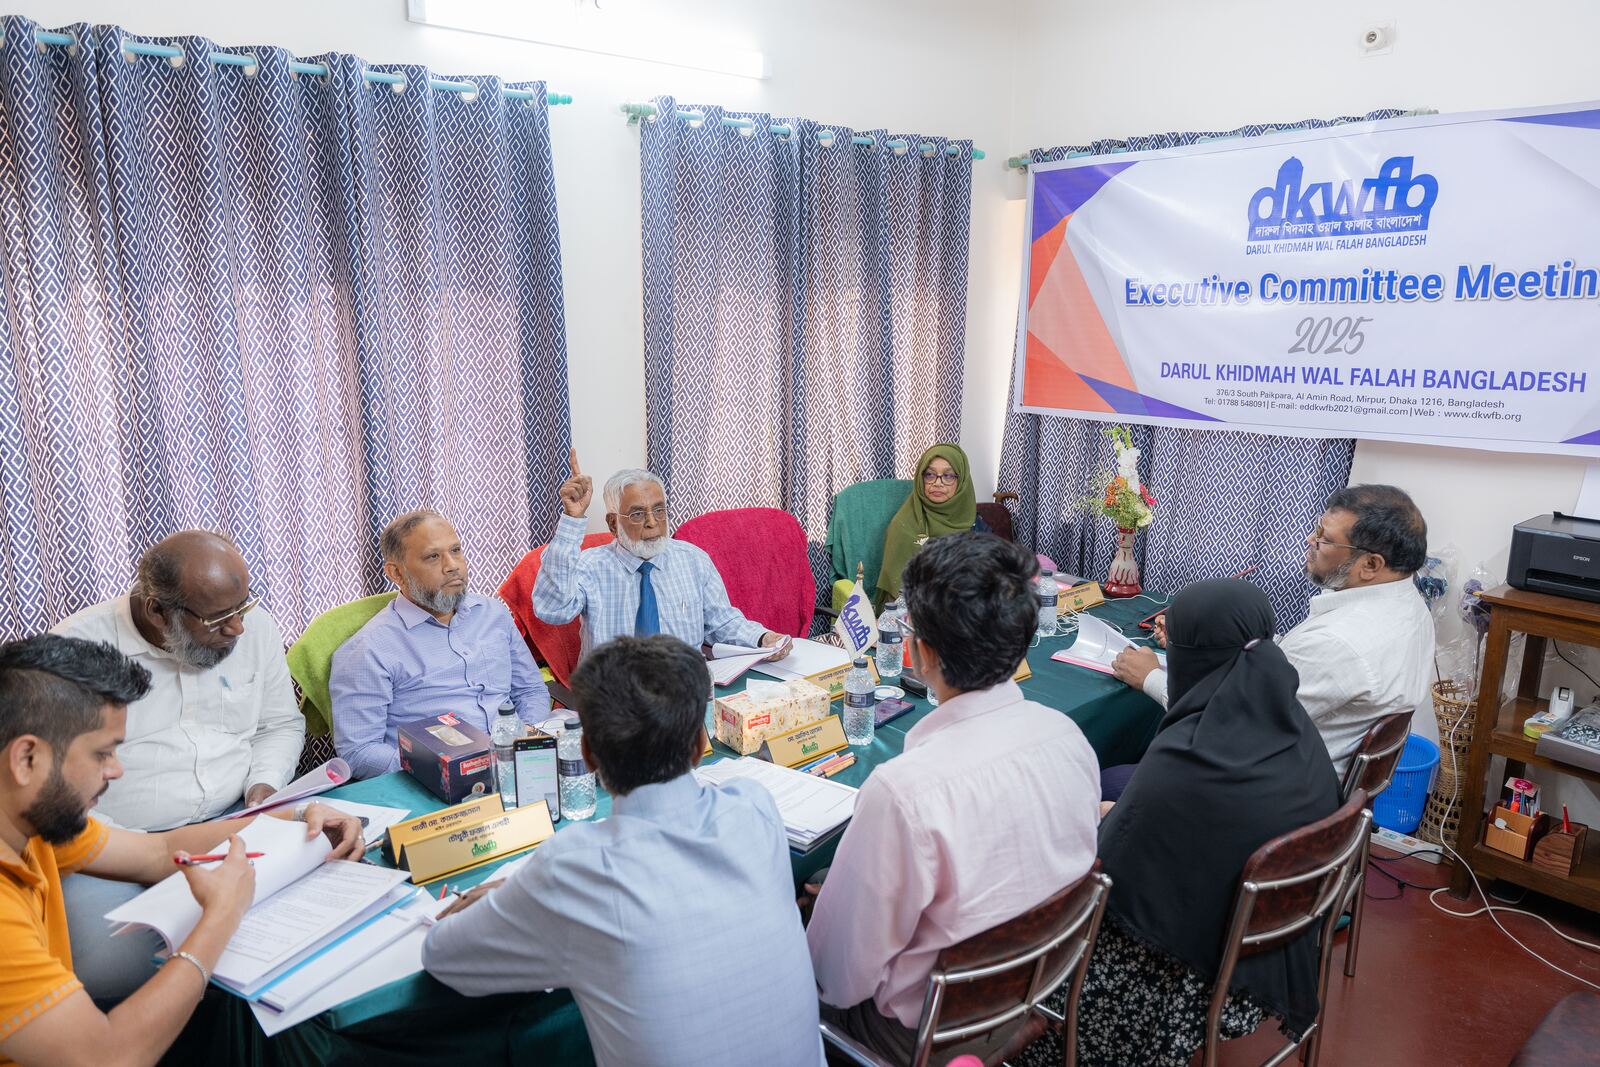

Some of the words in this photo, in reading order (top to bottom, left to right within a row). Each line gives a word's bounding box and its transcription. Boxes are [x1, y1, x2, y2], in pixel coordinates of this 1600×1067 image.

[1255, 225, 1280, 237] দারুল
[1344, 218, 1373, 232] ফালাহ
[1376, 213, 1423, 229] বাংলাদেশ
[1246, 242, 1271, 256] DARUL
[1273, 240, 1313, 254] KHIDMAH
[1315, 239, 1334, 252] WAL
[1335, 237, 1363, 250] FALAH
[1365, 234, 1427, 249] BANGLADESH
[1125, 274, 1250, 305] Executive
[1259, 272, 1443, 304] Committee
[1455, 260, 1600, 300] Meetin
[1287, 316, 1374, 355] 2025
[1160, 361, 1211, 380] DARUL
[1216, 363, 1296, 383] KHIDMAH
[1302, 366, 1344, 385] WAL
[1350, 367, 1416, 388] FALAH
[1422, 369, 1587, 393] BANGLADESH
[1204, 397, 1216, 405] Tel:
[1217, 398, 1239, 407] 01788
[1270, 402, 1297, 410] E-mail:
[1414, 408, 1435, 417] Web
[1443, 410, 1522, 423] www.dkwfb.org
[1216, 388, 1235, 397] 376/3
[1236, 389, 1259, 398] South
[1260, 391, 1294, 400] Paikpara,
[1295, 392, 1304, 400] Al
[1306, 393, 1328, 401] Amin
[1330, 393, 1354, 403] Road,
[1356, 395, 1387, 405] Mirpur,
[1389, 396, 1417, 405] Dhaka
[1420, 397, 1445, 408] 1216,
[1447, 398, 1505, 409] Bangladesh
